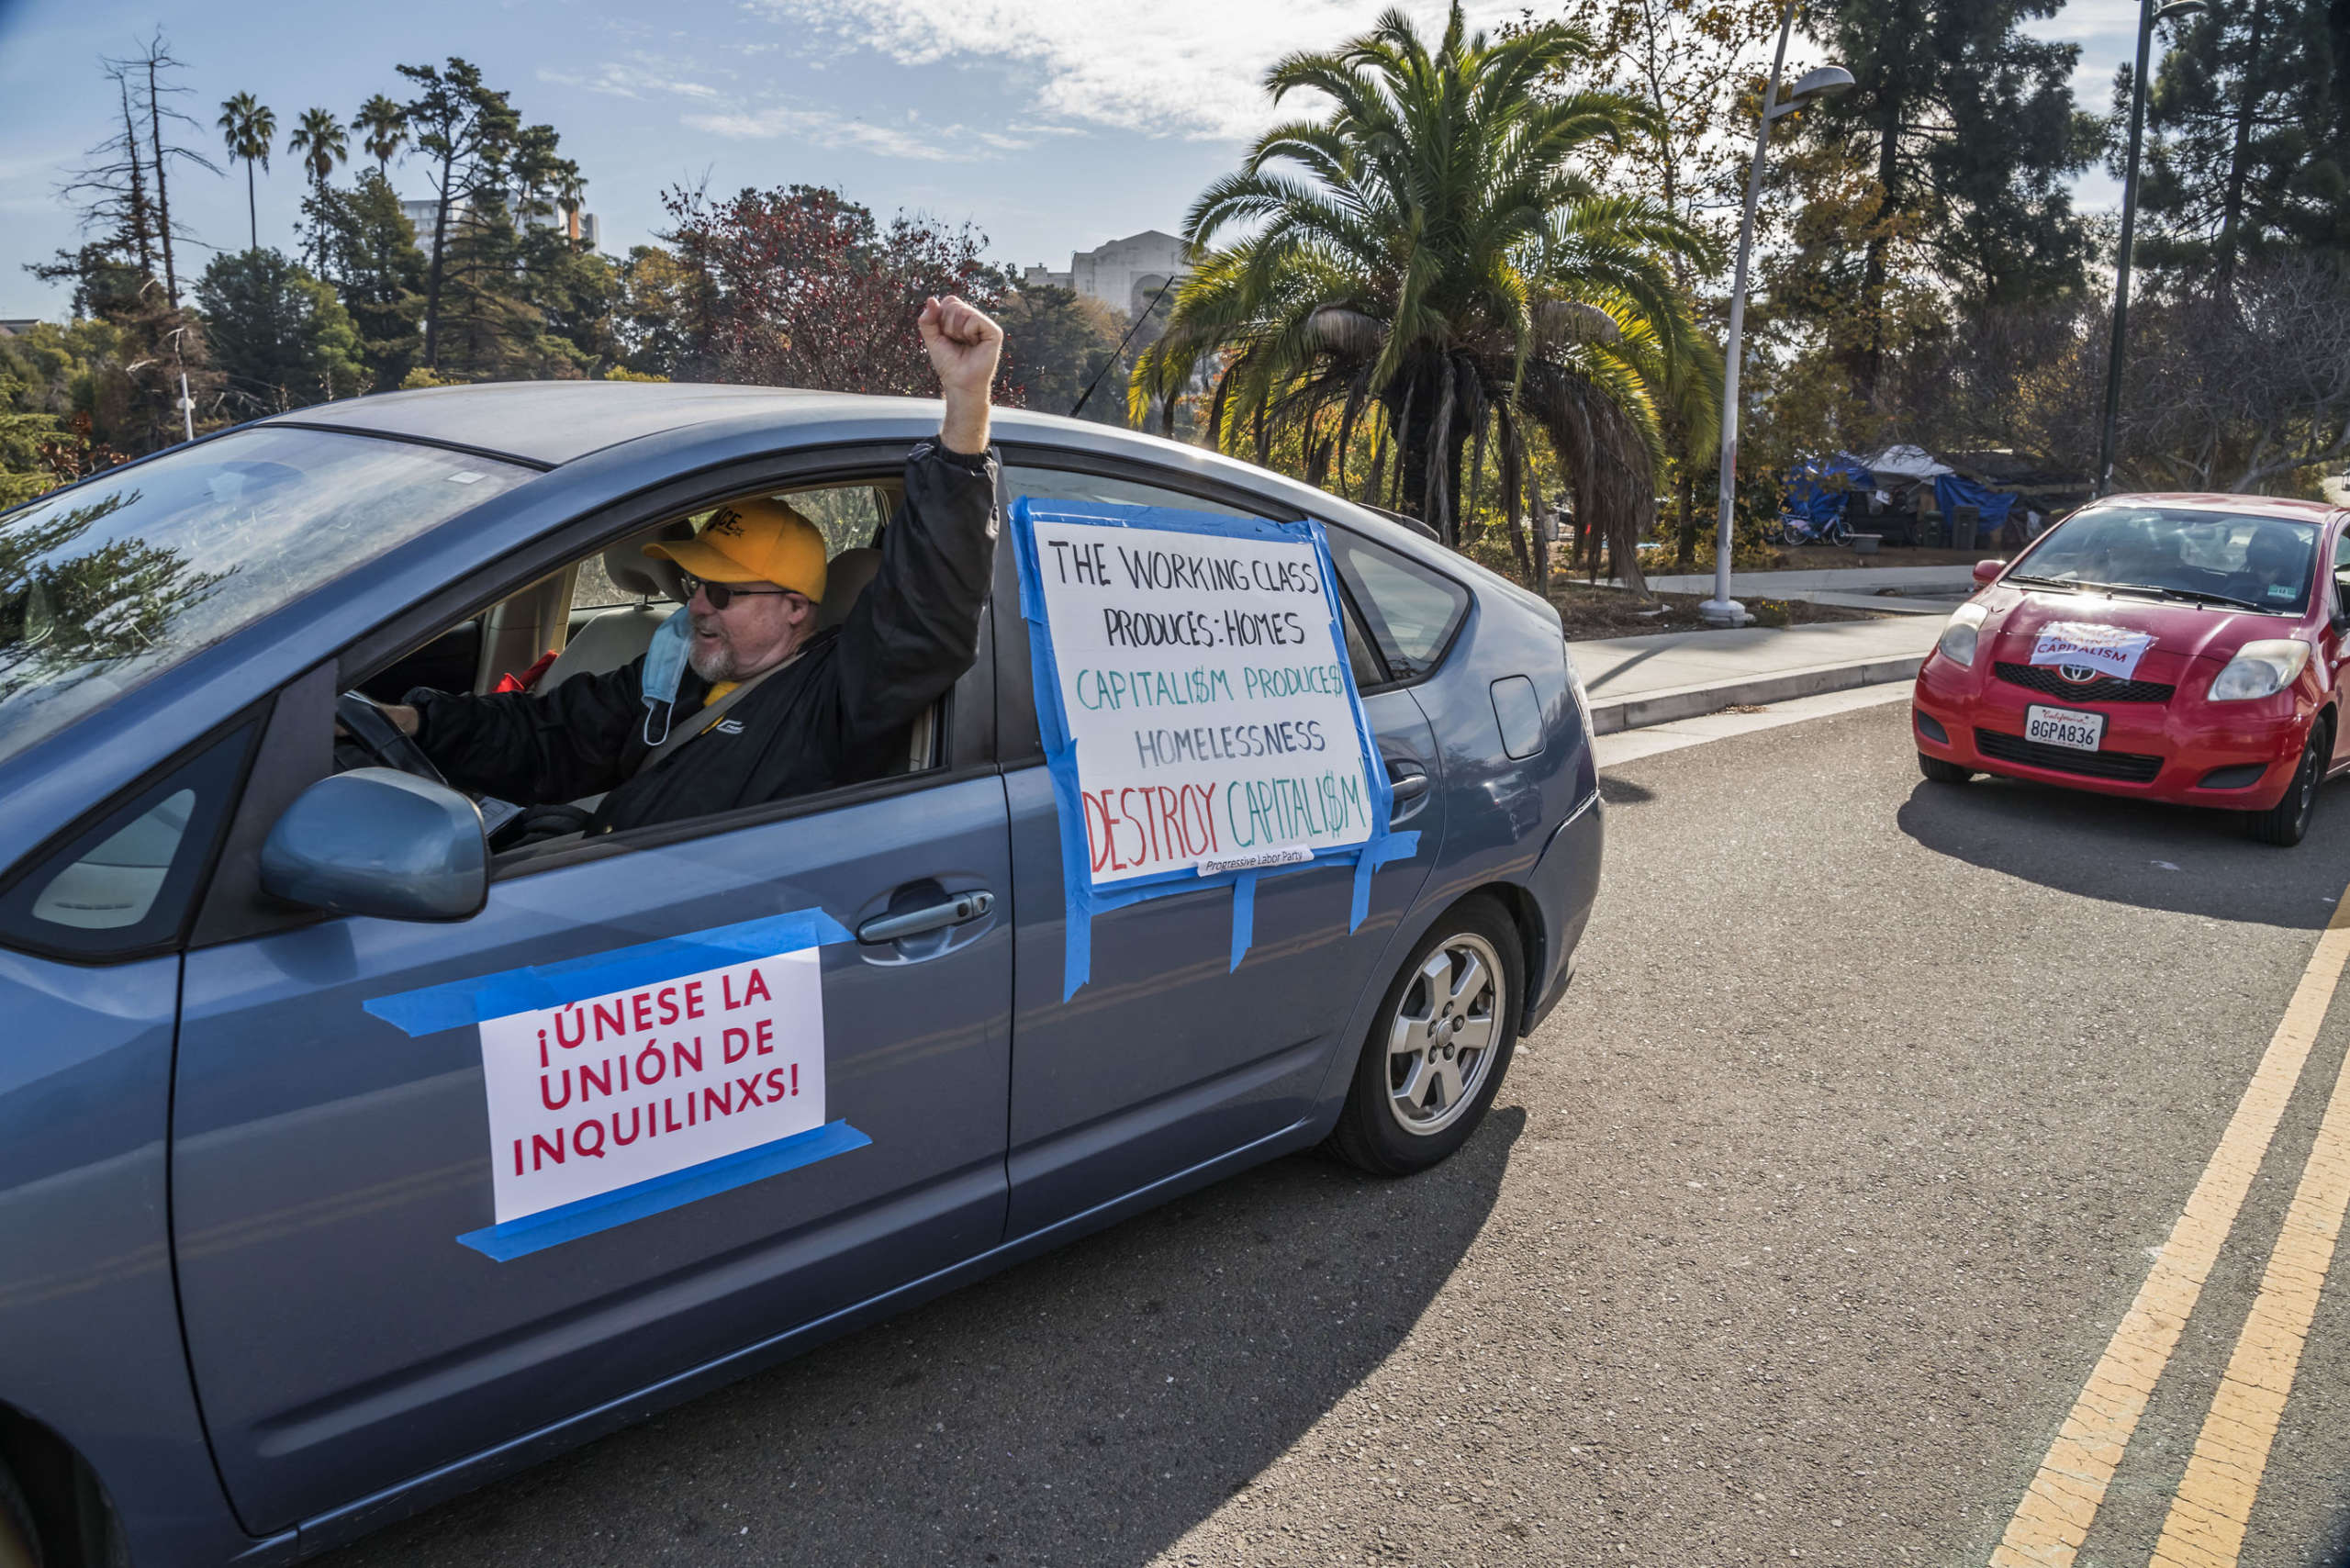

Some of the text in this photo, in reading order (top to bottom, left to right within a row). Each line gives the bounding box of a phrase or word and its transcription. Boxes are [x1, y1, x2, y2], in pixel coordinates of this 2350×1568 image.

[1048, 540, 1319, 595] THE WORKING CLASS
[1225, 608, 1305, 646] HOMES
[1134, 720, 1326, 769] HOMELESSNESS
[2031, 720, 2096, 745] 8GPA836
[1080, 780, 1219, 873] DESTROY
[1205, 850, 1304, 871] Progressive Labor Party
[537, 967, 773, 1068] ¡ÚNESE LA
[540, 1018, 776, 1111] UNIÓN DE
[513, 1063, 800, 1177] INQUILINXS!
